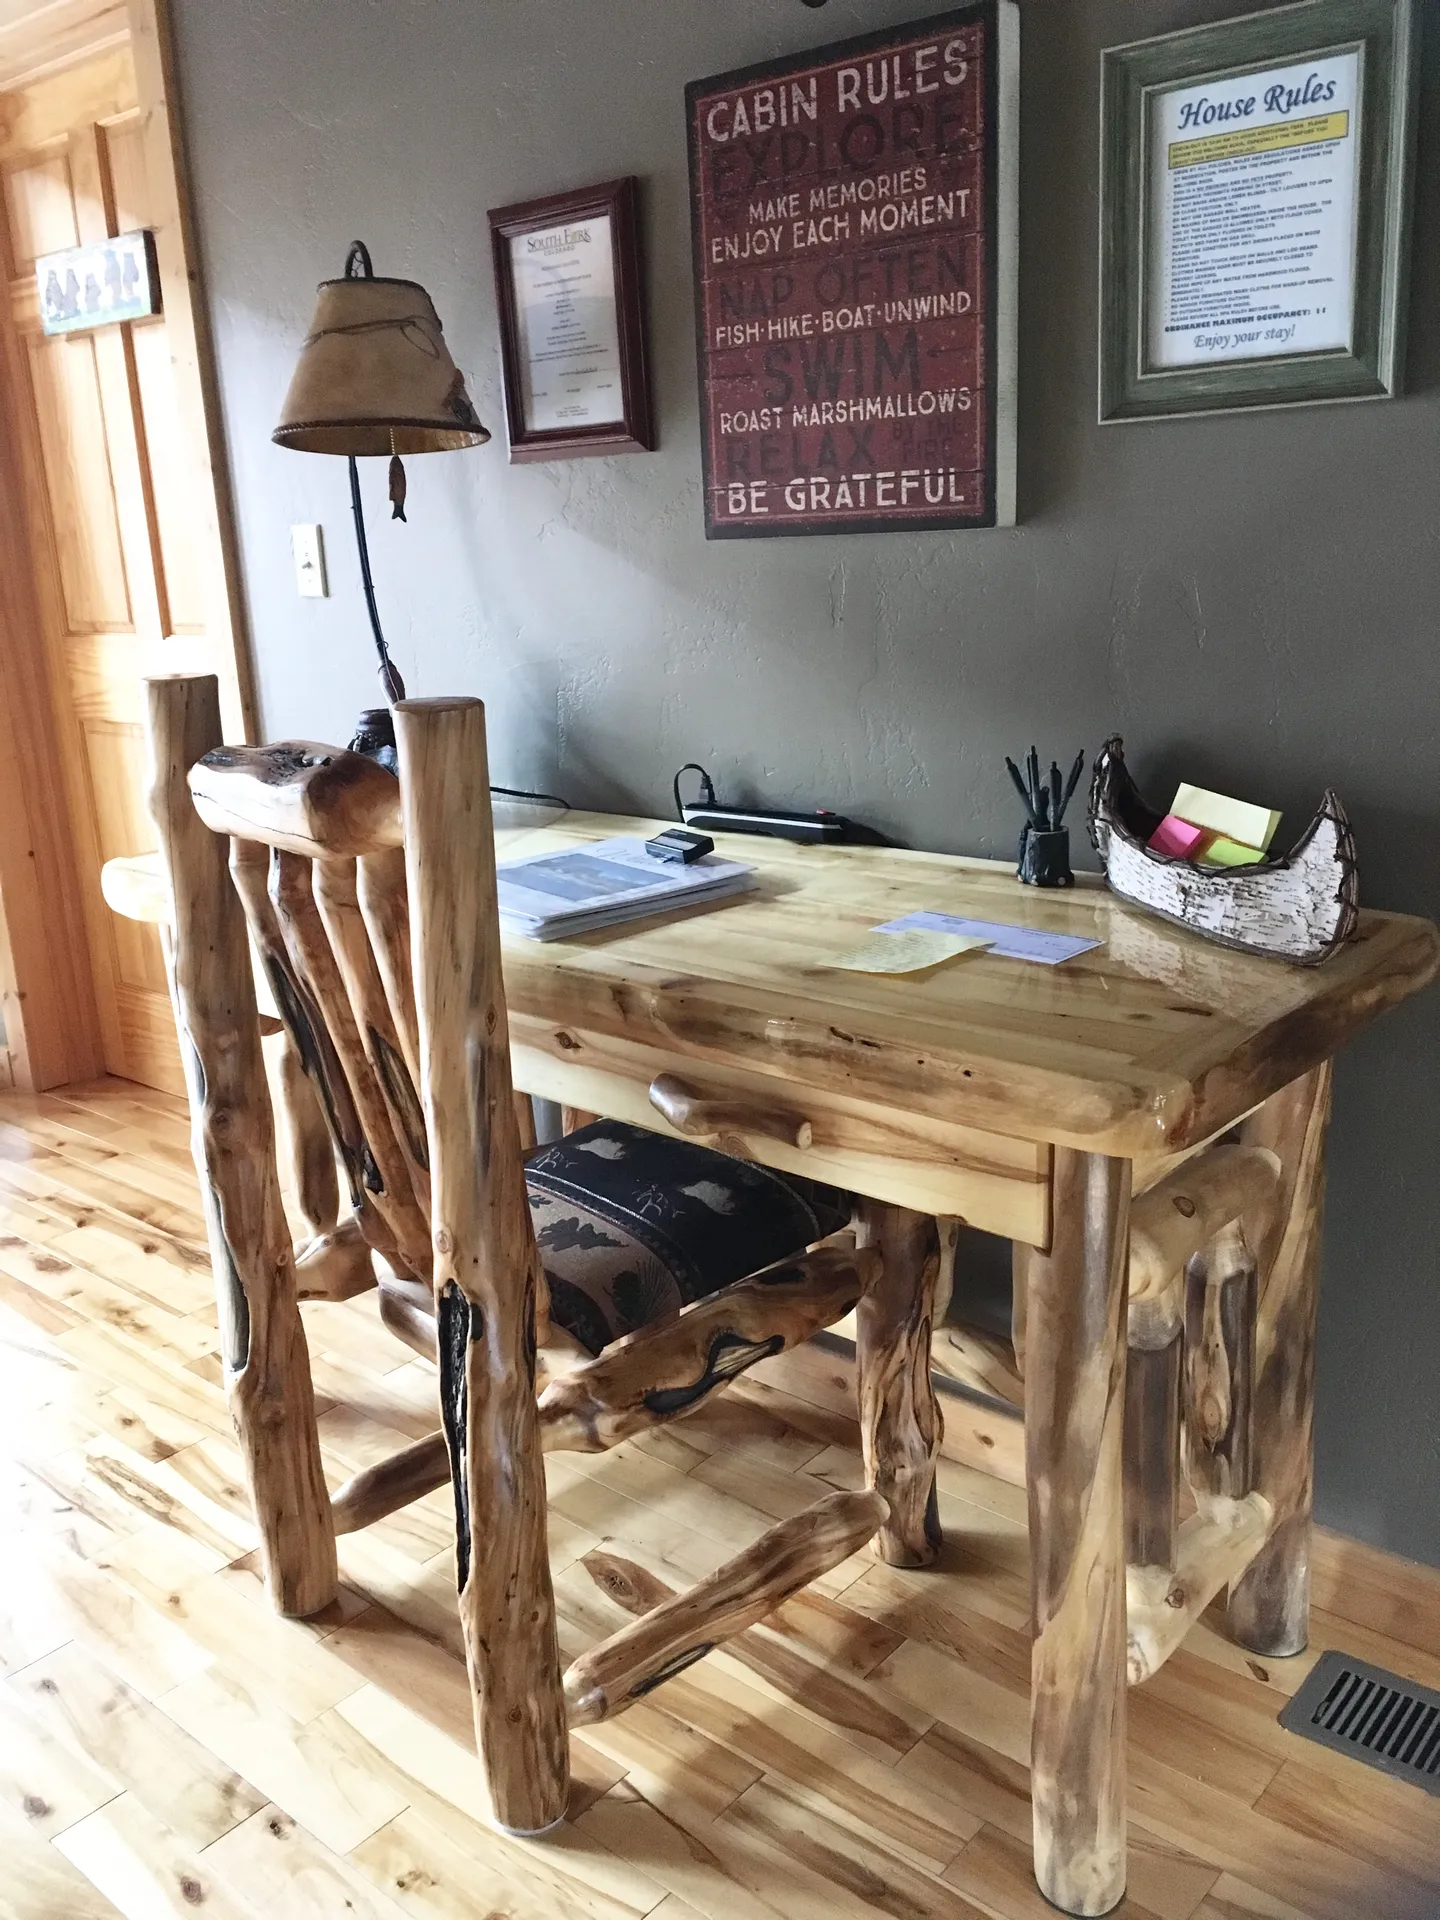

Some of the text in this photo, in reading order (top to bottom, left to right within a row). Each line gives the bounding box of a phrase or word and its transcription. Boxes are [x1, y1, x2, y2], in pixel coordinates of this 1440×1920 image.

[707, 39, 968, 141] CABIN RULES
[1178, 73, 1337, 130] House Rules
[750, 167, 927, 224] MAKE MEMORIES
[711, 189, 970, 263] ENJOY EACH MOMENT
[813, 243, 967, 311] OFTEN
[1194, 324, 1296, 350] Enjoy your stay!
[1212, 315, 1254, 326] MAXIMUM
[763, 326, 922, 409] SWIM
[720, 386, 972, 434] ROAST MARSHMALLOWS
[724, 423, 877, 480] RELAX
[728, 468, 965, 514] BE GRATEFUL
